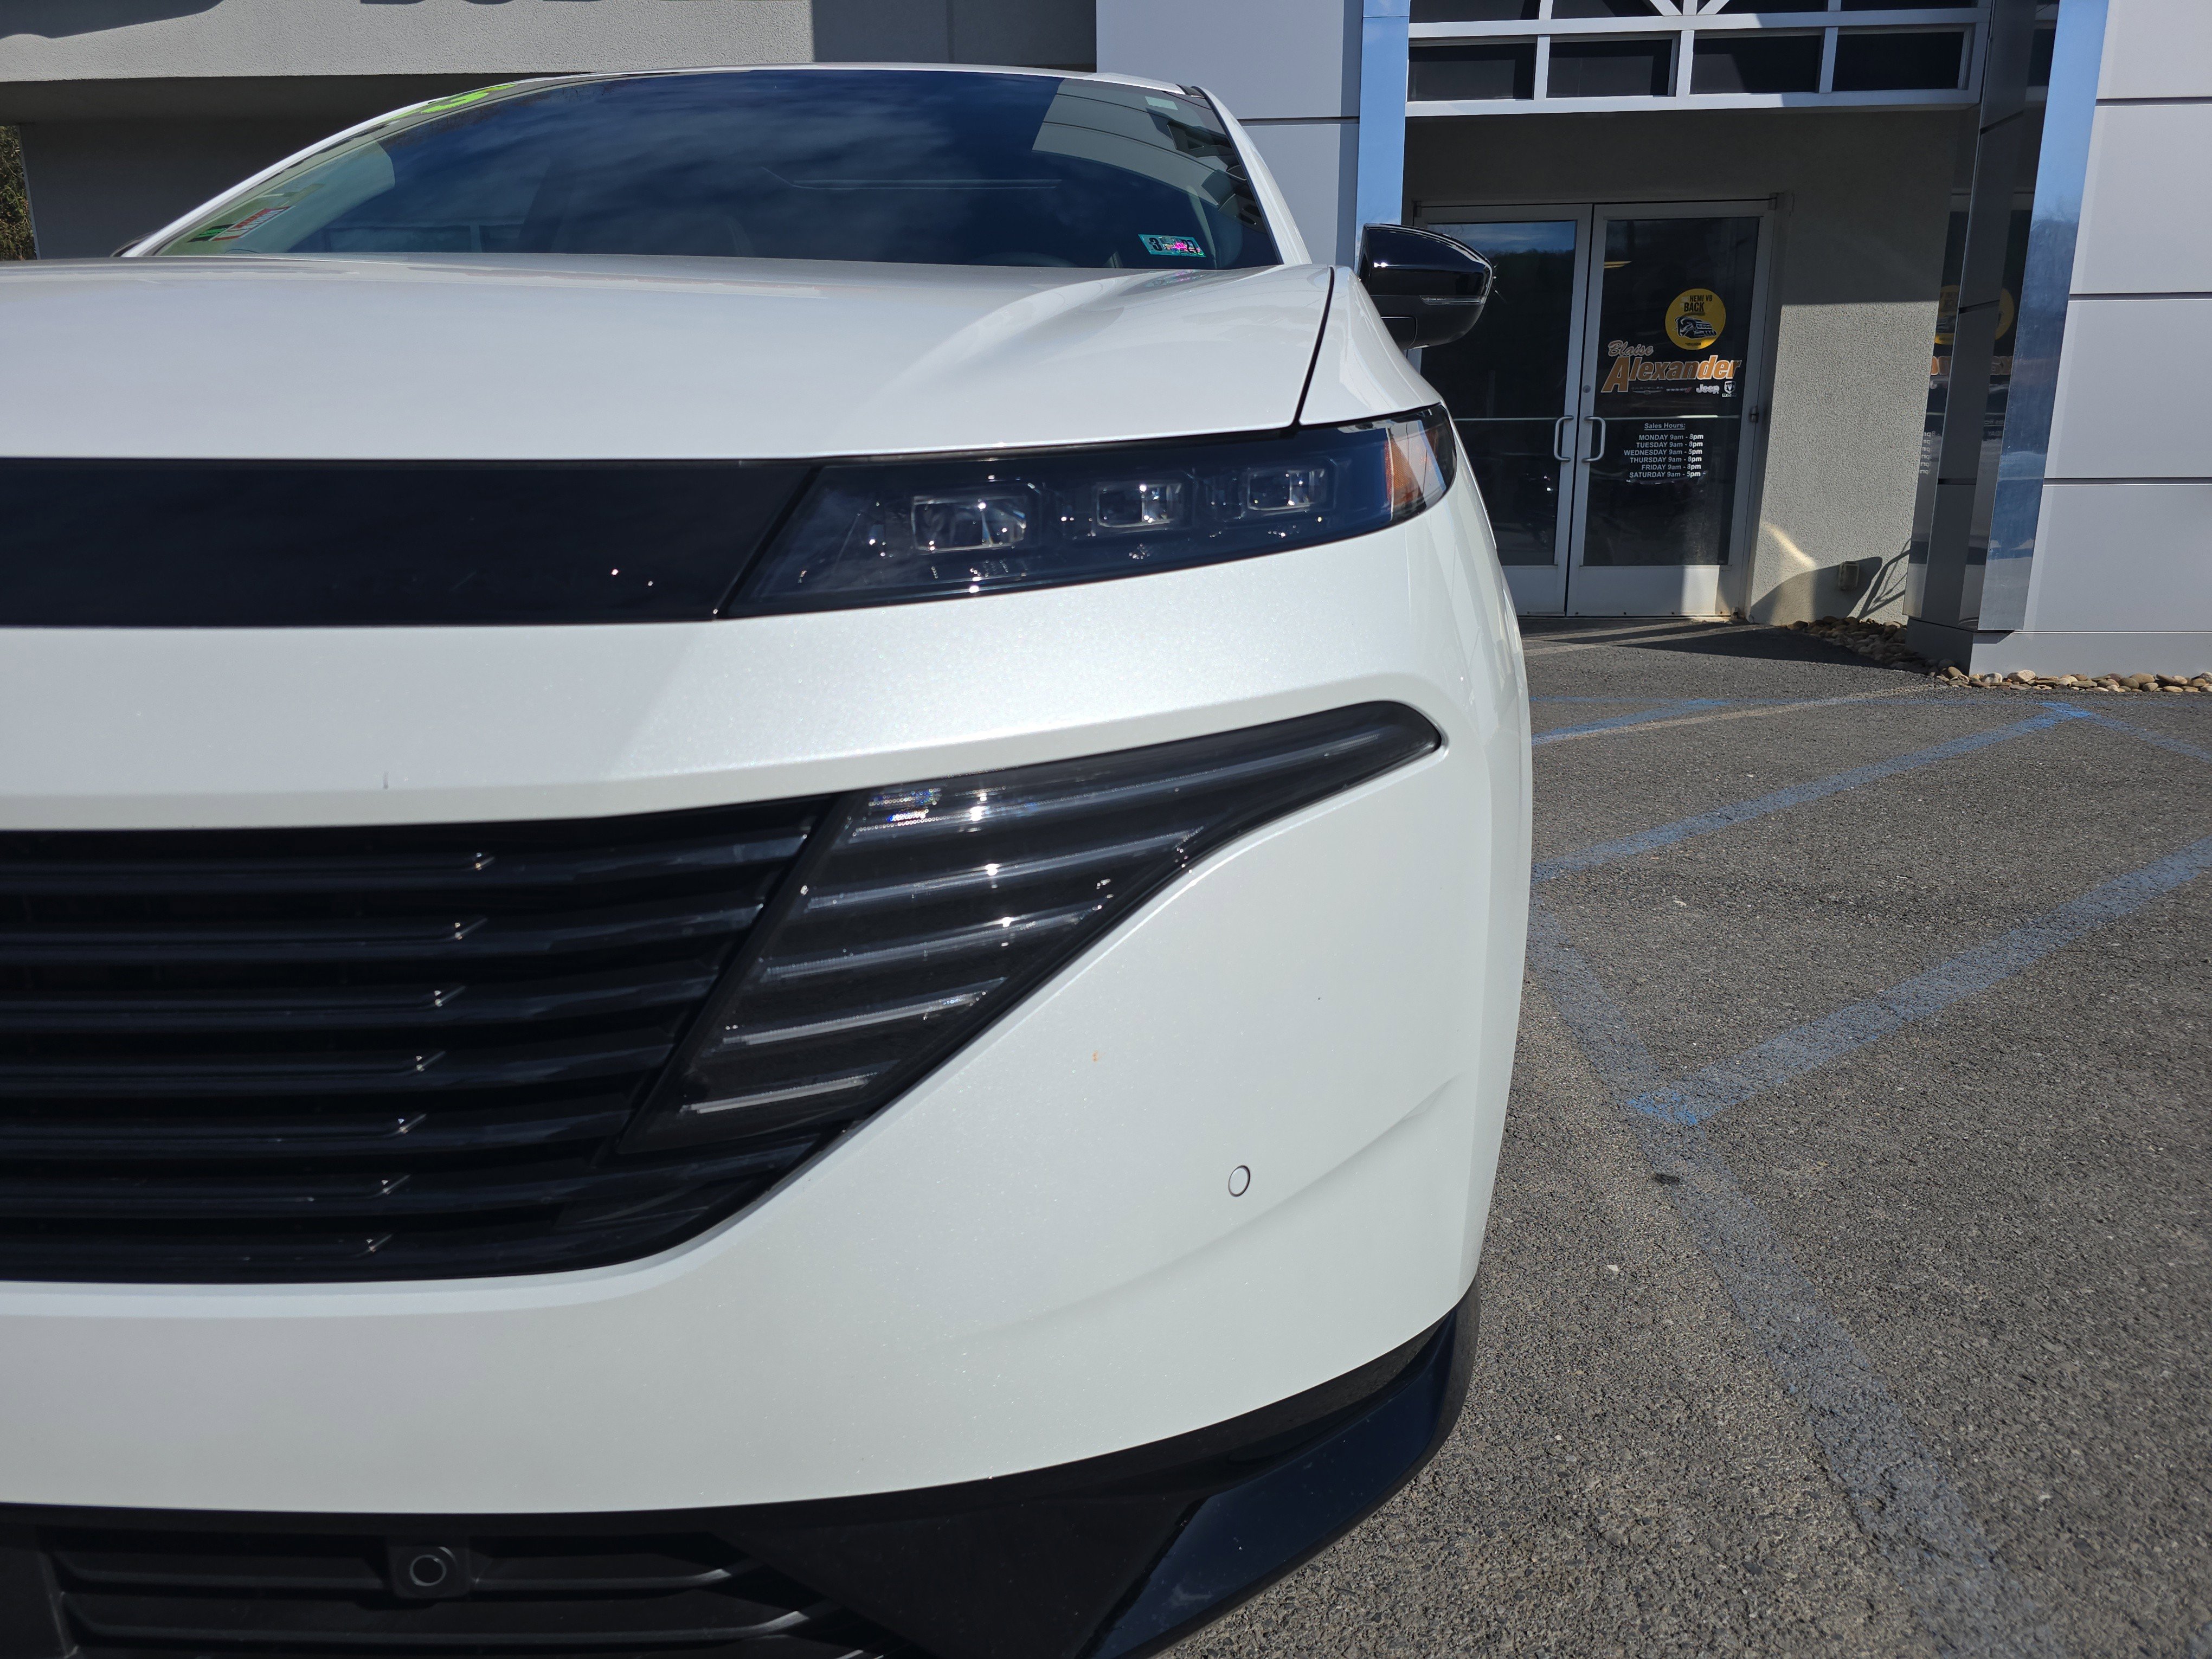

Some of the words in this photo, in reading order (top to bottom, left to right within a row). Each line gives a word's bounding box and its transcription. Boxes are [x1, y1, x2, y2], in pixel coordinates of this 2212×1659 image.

[1684, 302, 1705, 312] BACK
[1607, 340, 1654, 357] Blaise
[1601, 355, 1742, 393] Alexander
[1695, 384, 1720, 394] Jeep
